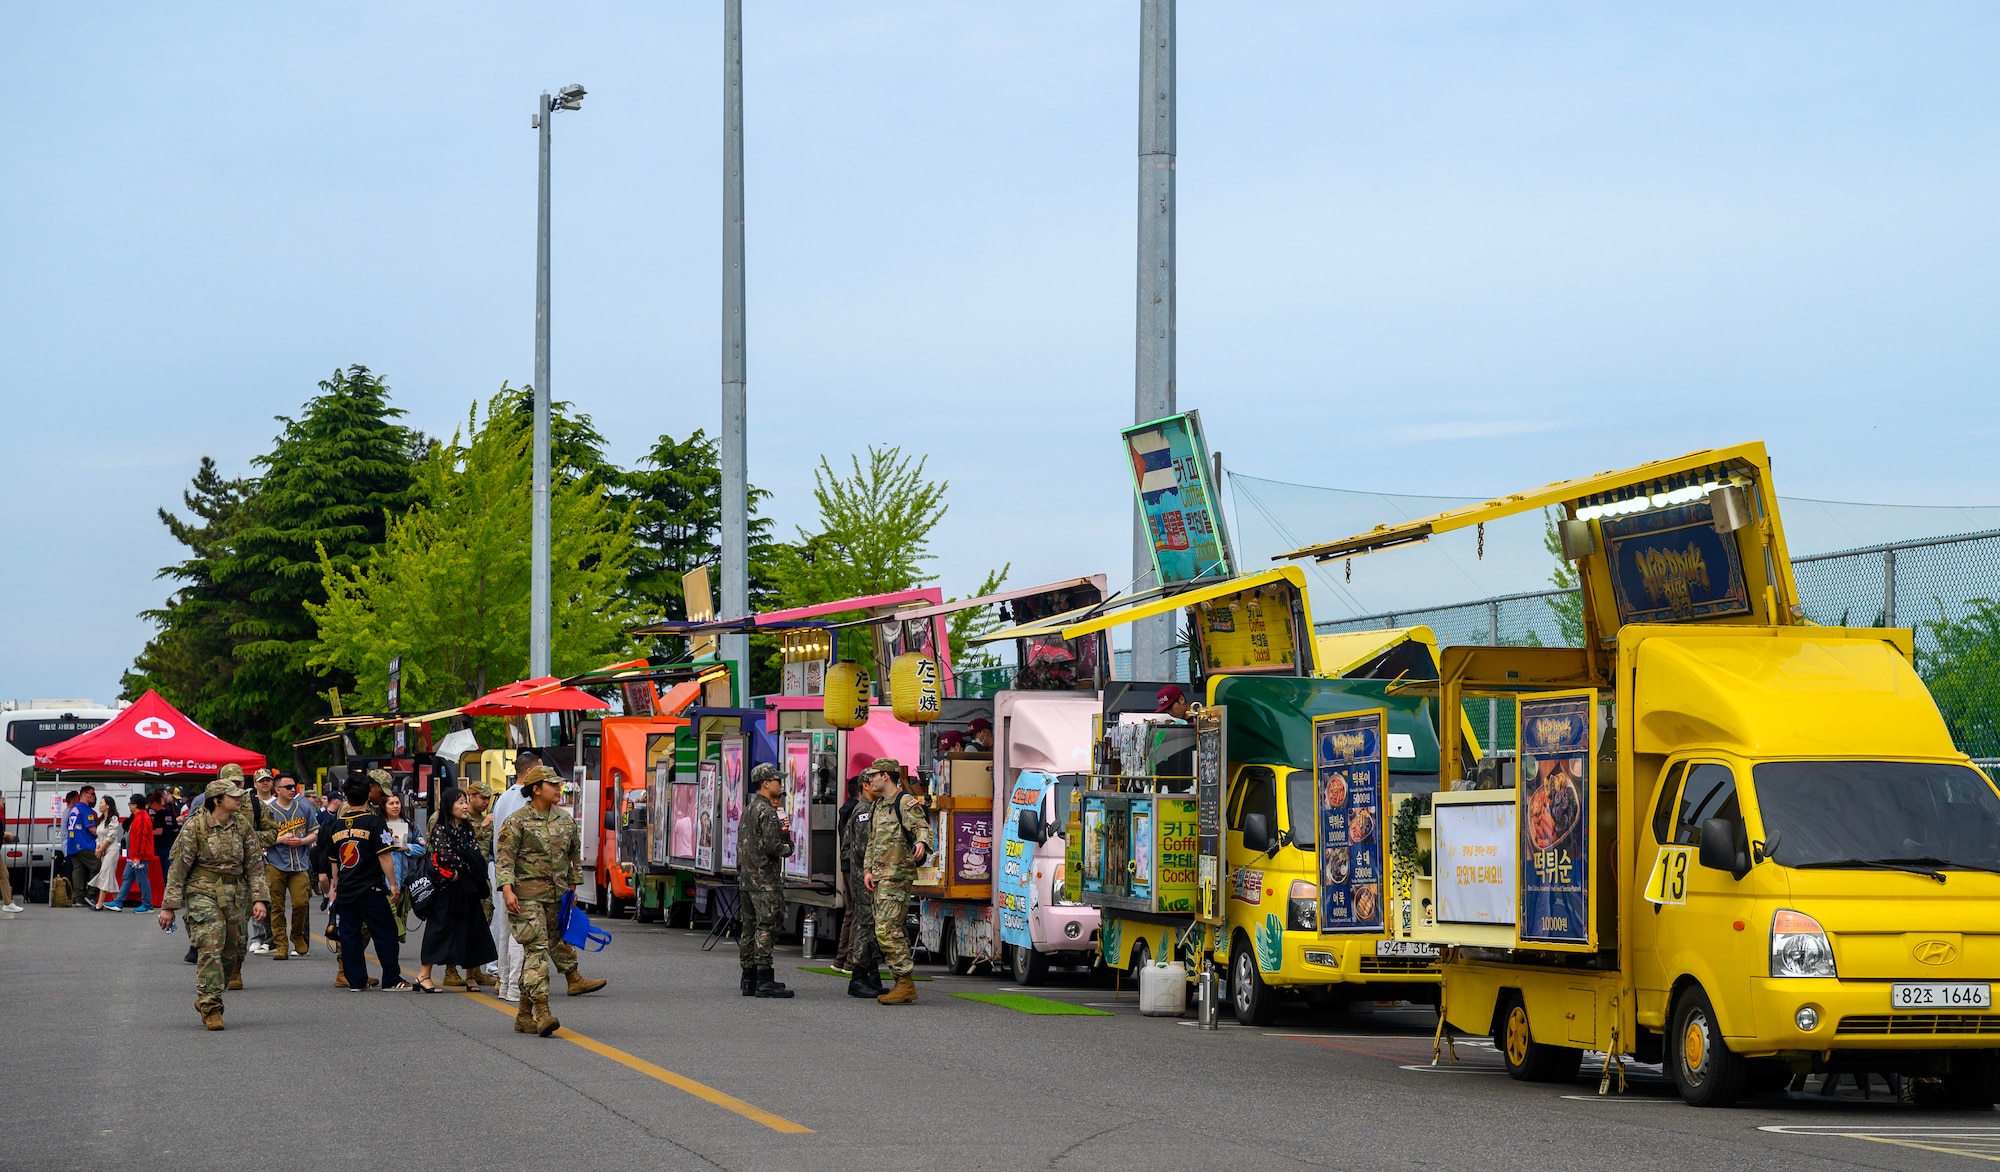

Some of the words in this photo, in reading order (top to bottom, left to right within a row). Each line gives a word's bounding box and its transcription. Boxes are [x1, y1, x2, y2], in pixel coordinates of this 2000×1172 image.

[1192, 538, 1219, 562] Cocktai
[916, 658, 939, 713] たこ焼
[854, 671, 869, 721] たこ焼
[58, 723, 75, 731] 사랑을
[104, 758, 158, 768] American
[162, 759, 183, 769] Red
[186, 760, 218, 770] Cross
[1352, 770, 1371, 787] 떡볶이
[1352, 792, 1371, 805] 5000원
[961, 820, 992, 837] 元気
[1328, 814, 1345, 830] 떡튀순
[1163, 837, 1196, 852] Coffe
[1163, 853, 1196, 868] 칵테
[1533, 849, 1573, 884] 떡튀순
[1162, 868, 1196, 883] Cockt
[1354, 867, 1373, 879] 5000원
[1456, 866, 1476, 885] 맛있게
[1478, 866, 1503, 884] 드세요!!
[1660, 852, 1688, 900] 13
[1541, 917, 1568, 932] 10000원
[1902, 988, 1934, 1004] 82조
[1942, 987, 1982, 1004] 1646
